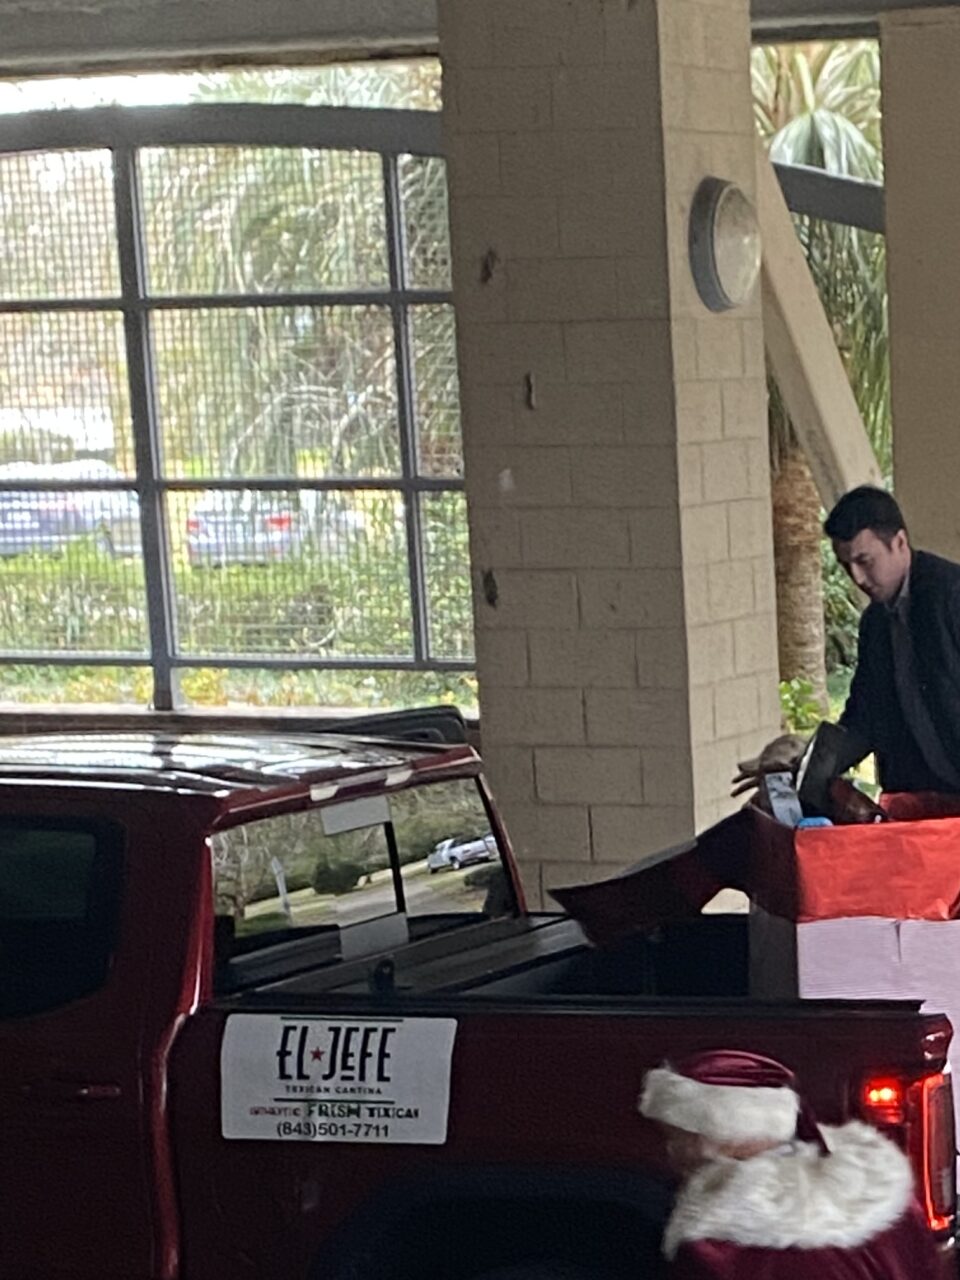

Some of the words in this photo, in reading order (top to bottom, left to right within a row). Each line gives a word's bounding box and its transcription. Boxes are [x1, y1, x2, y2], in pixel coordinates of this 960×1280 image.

[276, 1026, 310, 1080] EL
[322, 1026, 396, 1082] JEFE
[277, 1122, 389, 1138] (843)501-7711
